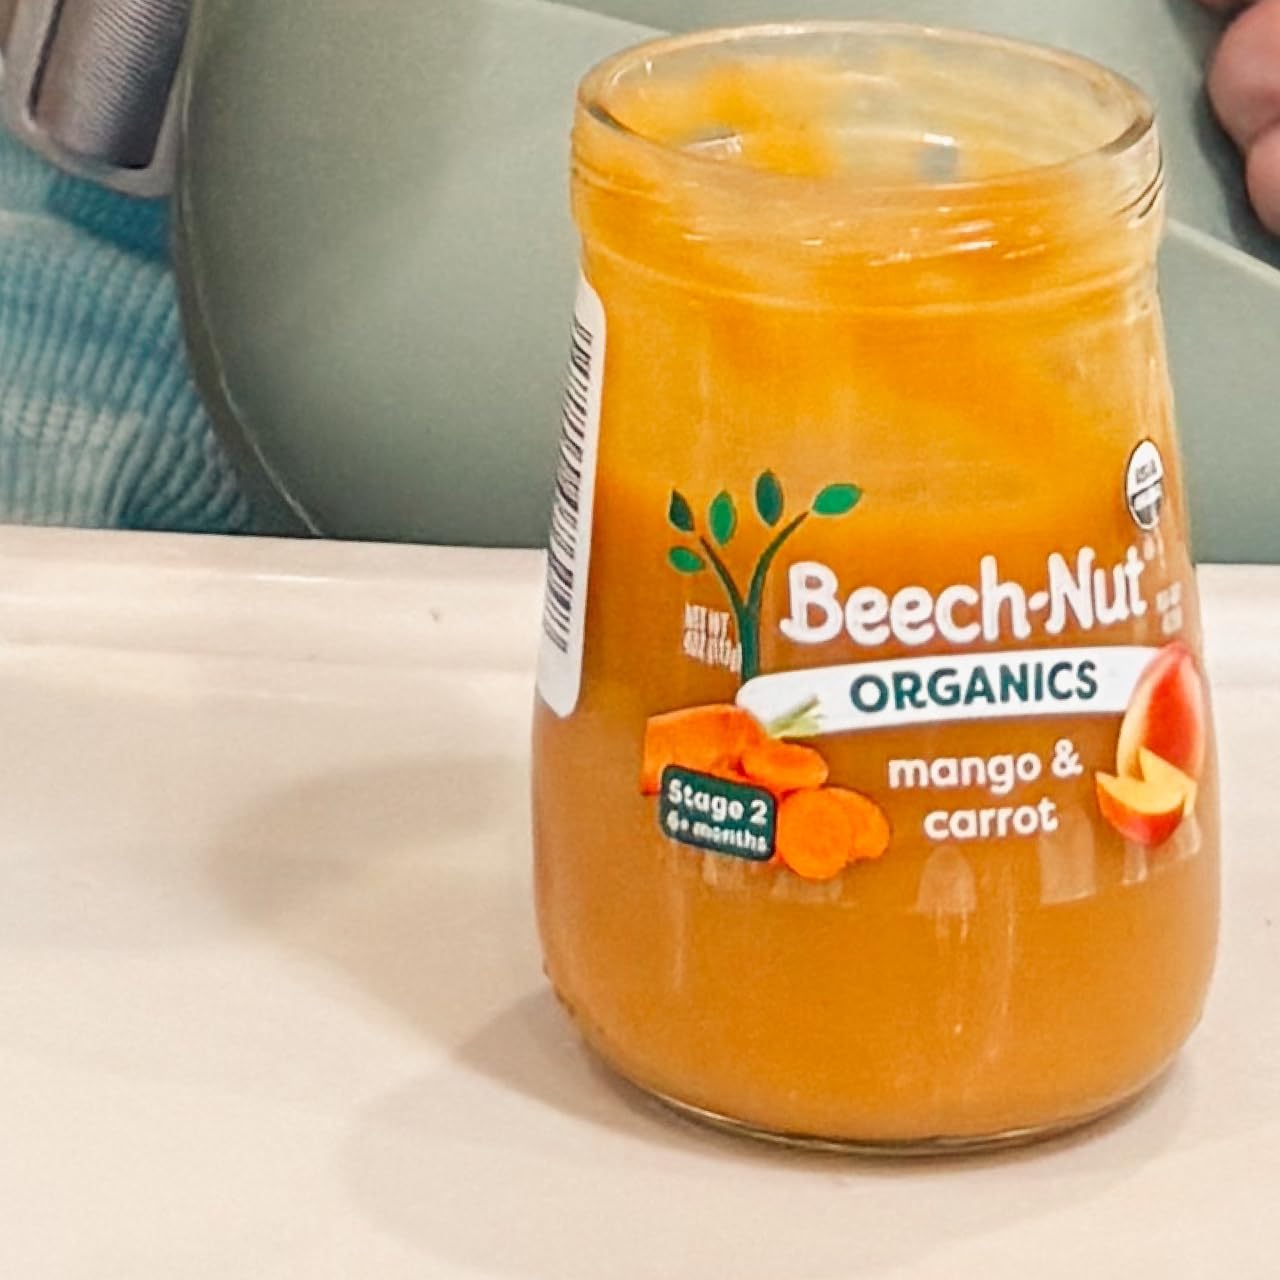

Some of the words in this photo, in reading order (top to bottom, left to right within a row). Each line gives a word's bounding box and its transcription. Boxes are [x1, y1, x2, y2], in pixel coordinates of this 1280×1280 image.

[778, 544, 1148, 647] Beech-Nut
[849, 659, 1099, 714] ORGANICS
[887, 751, 1042, 796] mango
[1050, 737, 1084, 779] &
[667, 778, 745, 823] Stage
[749, 798, 768, 826] 2
[923, 795, 1059, 840] carrot
[692, 820, 768, 853] months
